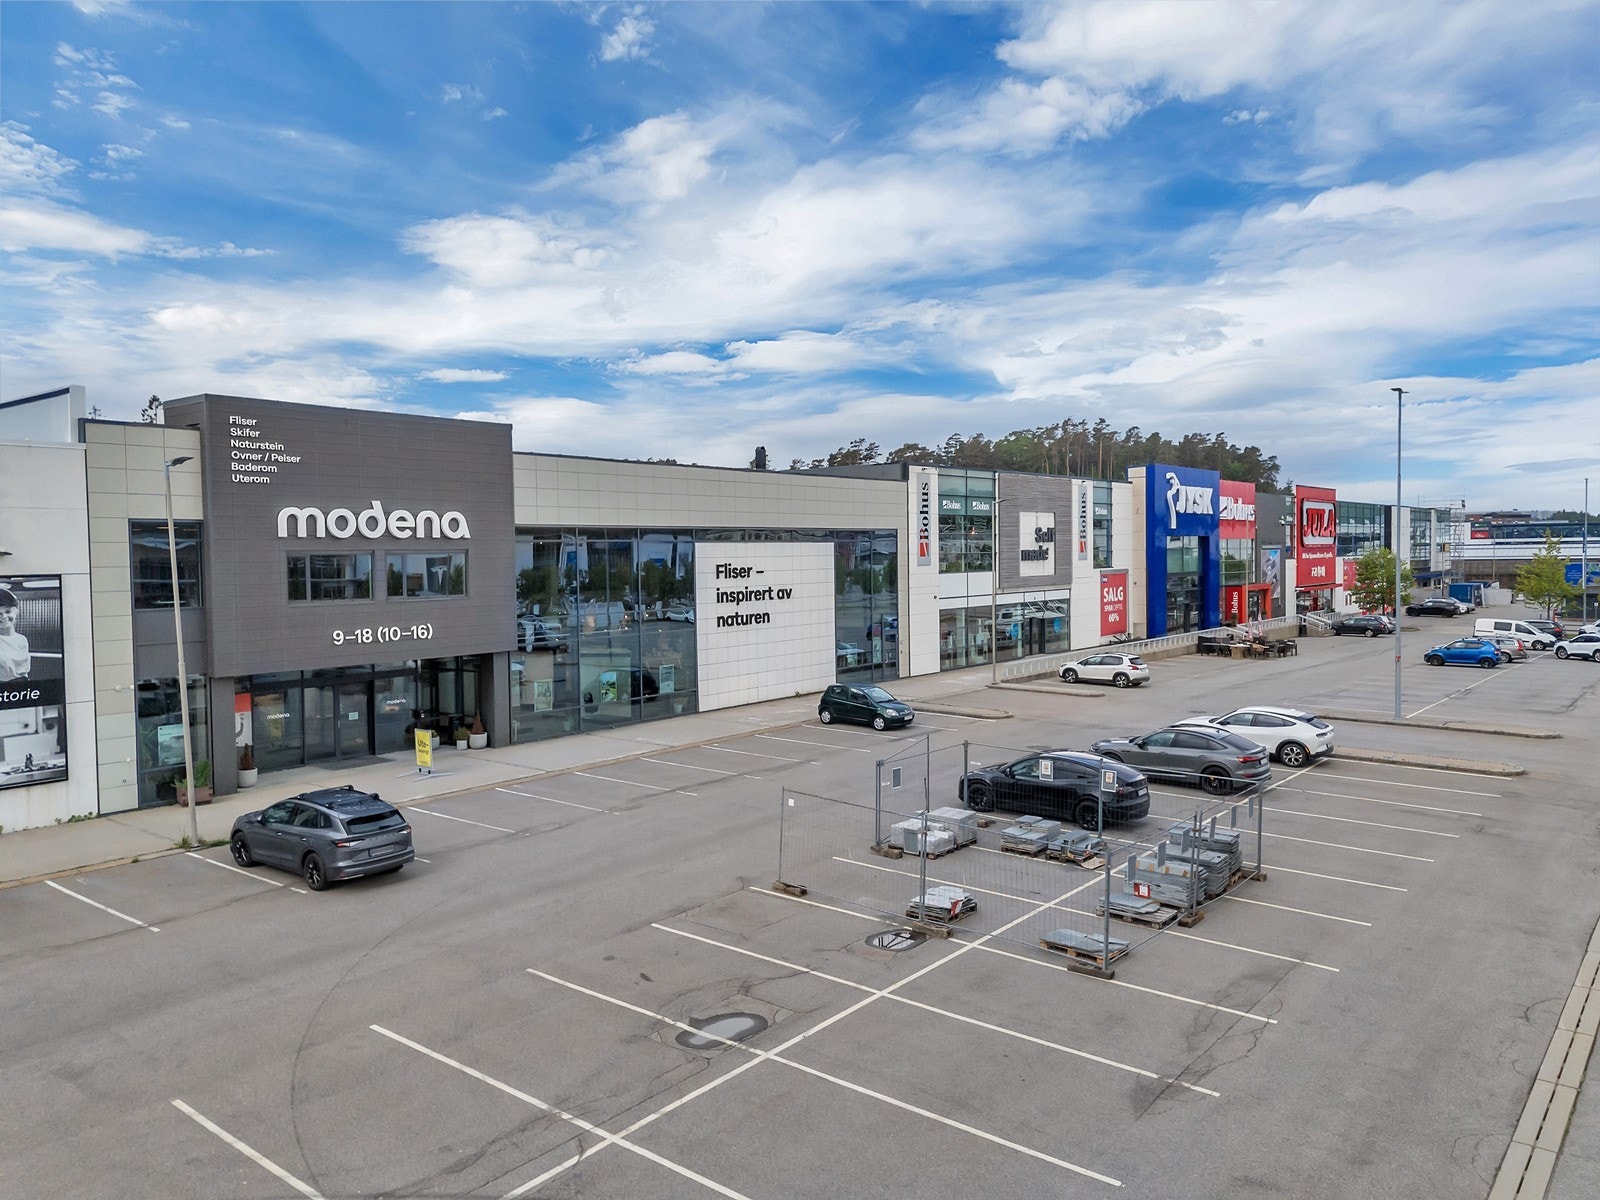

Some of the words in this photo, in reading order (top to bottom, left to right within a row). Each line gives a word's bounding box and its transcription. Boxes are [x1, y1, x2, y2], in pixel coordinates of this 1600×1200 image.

[229, 415, 257, 426] Fliser
[230, 427, 260, 438] Skifer
[230, 439, 284, 451] Naturstein
[231, 451, 262, 462] Ovner
[271, 453, 301, 463] Peiser
[231, 462, 277, 473] Baderom
[231, 474, 270, 484] Uterom
[1176, 486, 1213, 514] JYSK
[1226, 496, 1255, 521] Bohus
[920, 482, 929, 539] Bohus
[277, 500, 471, 539] modena
[1304, 508, 1335, 538] JULA
[1021, 545, 1049, 561] made
[715, 563, 752, 579] Fliser
[716, 586, 774, 605] inspirert
[777, 588, 793, 600] av
[1103, 586, 1124, 603] SALG
[1231, 591, 1239, 614] Bohus
[717, 611, 770, 628] naturen
